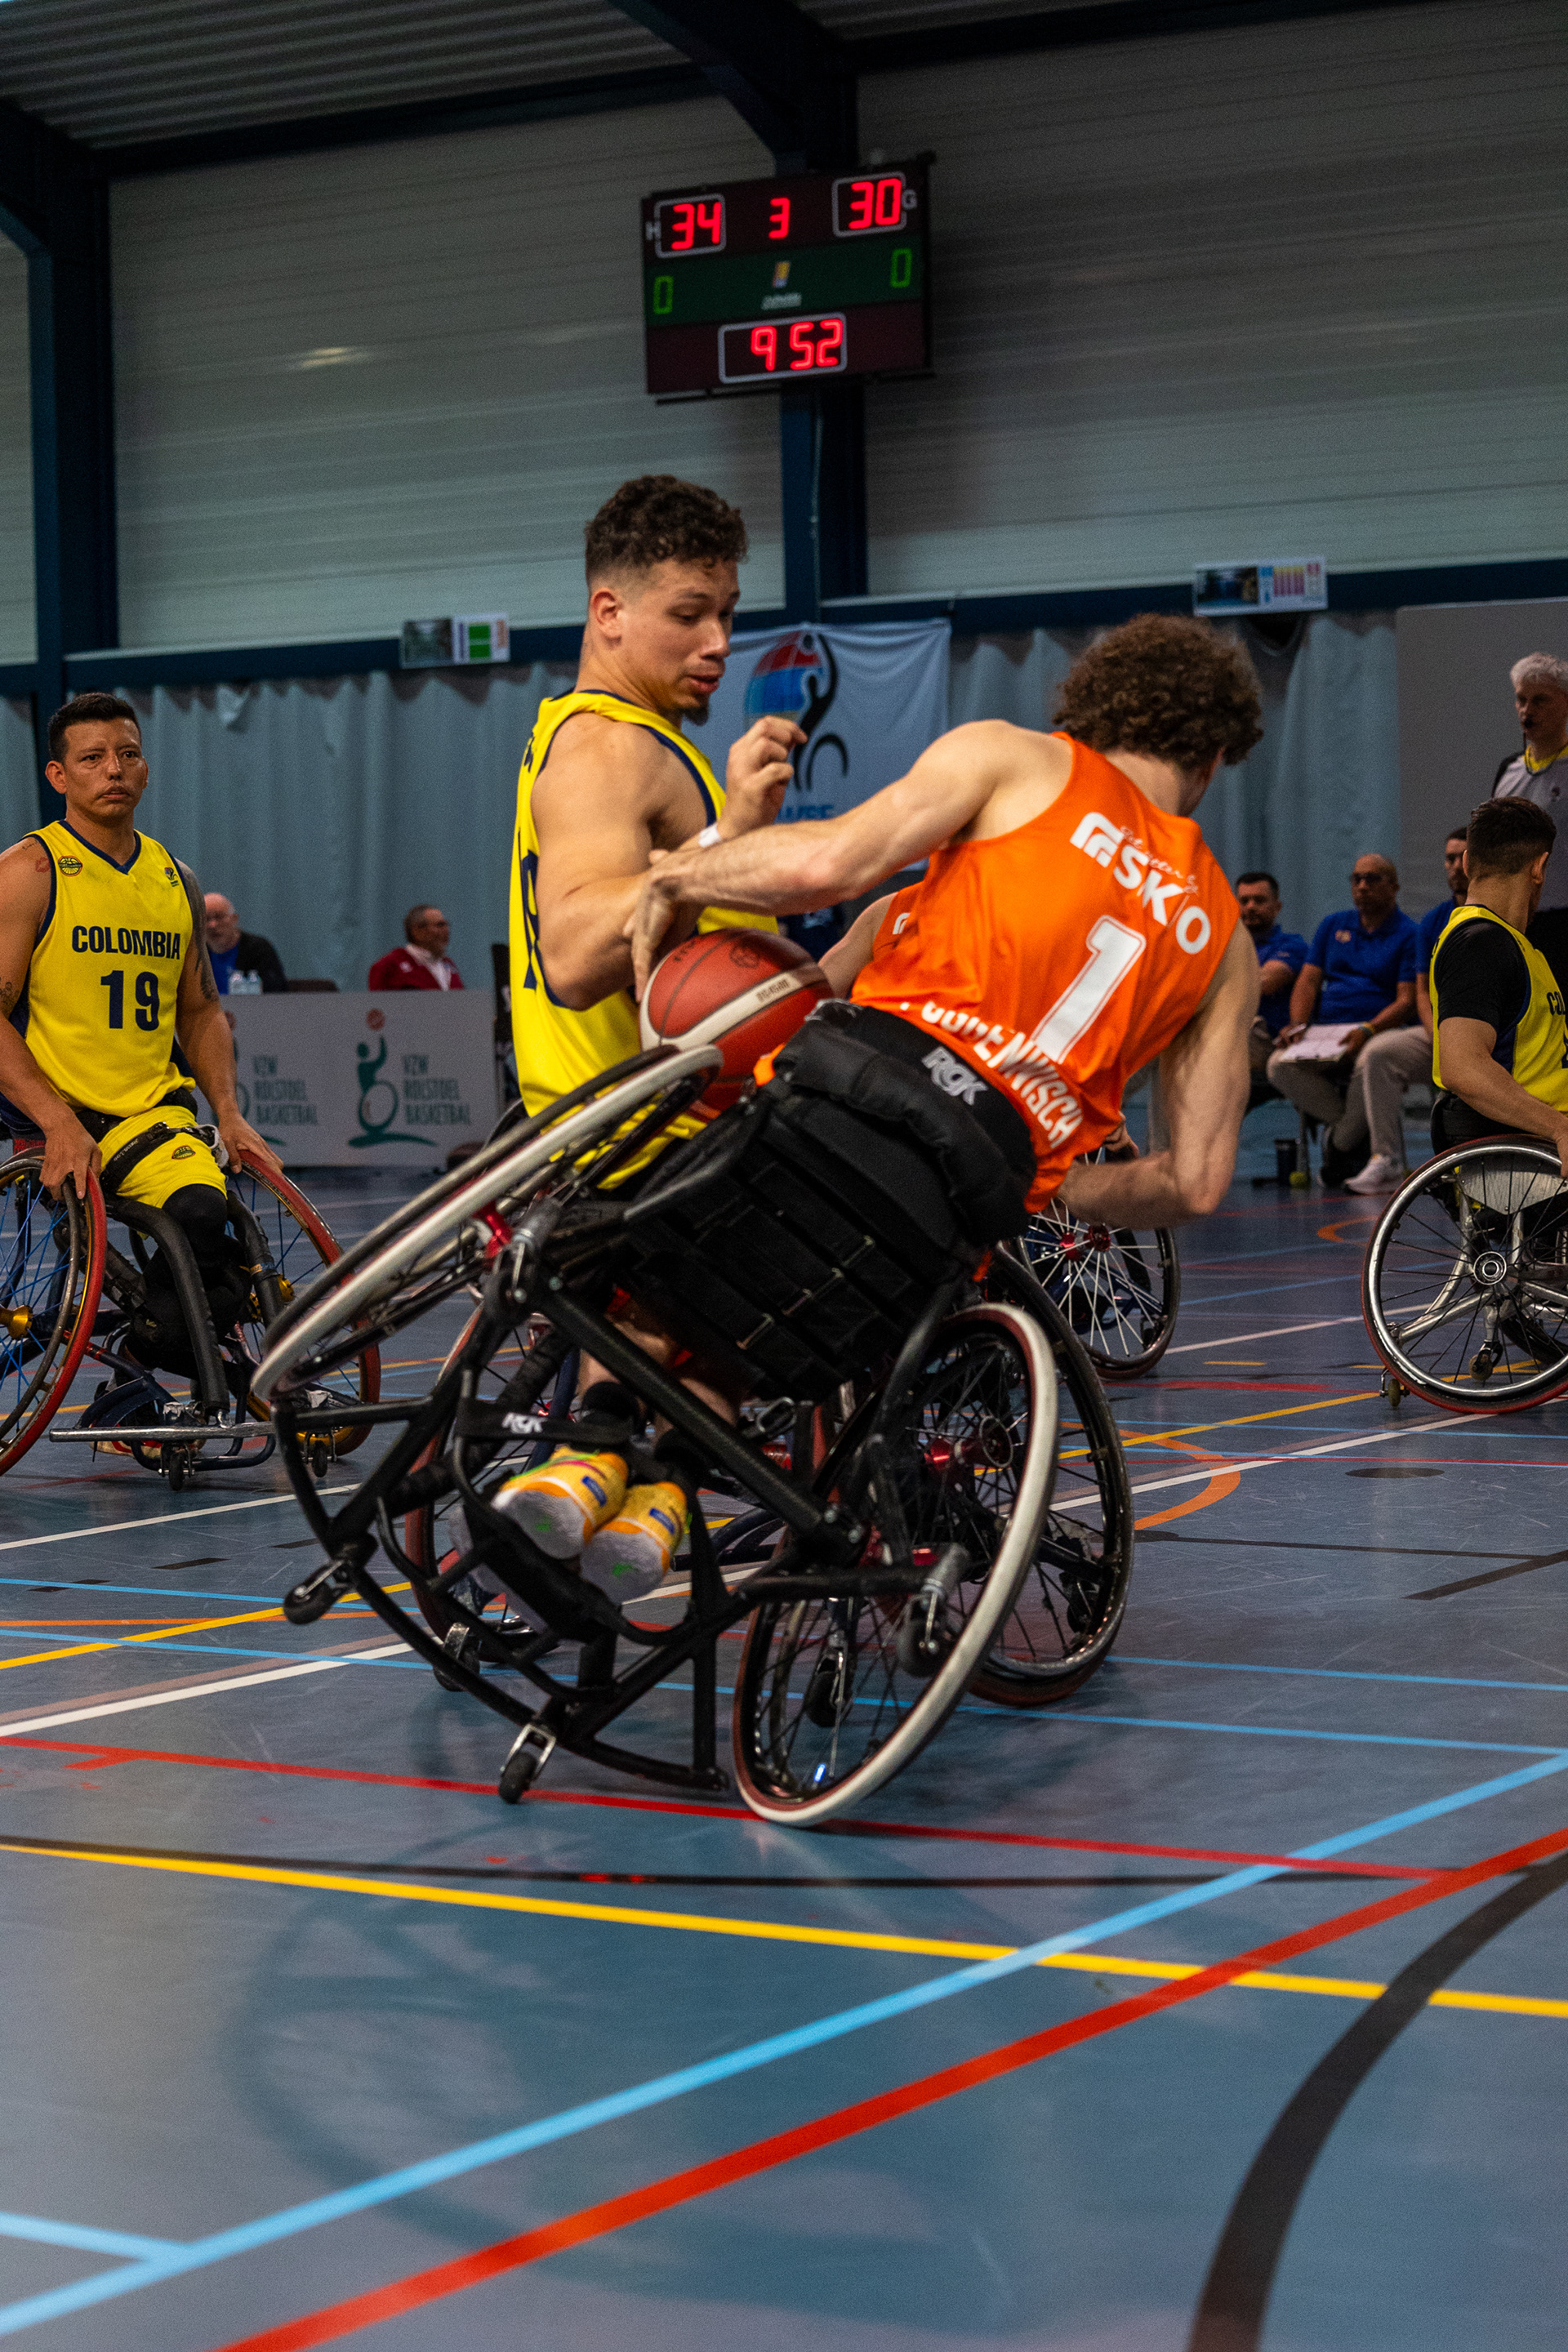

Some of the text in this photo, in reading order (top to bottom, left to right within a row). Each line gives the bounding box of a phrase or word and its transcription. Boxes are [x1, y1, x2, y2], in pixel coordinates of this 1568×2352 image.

[768, 198, 791, 239] 3
[848, 178, 902, 229] 30
[902, 189, 918, 209] G
[671, 203, 721, 251] 34
[889, 247, 912, 287] 0
[653, 275, 674, 314] 0
[1070, 812, 1211, 954] ASKO
[72, 925, 180, 960] COLOMBIA
[100, 969, 160, 1031] 19
[1031, 915, 1147, 1064] 1
[899, 1000, 1084, 1149] ENWISCH
[921, 1046, 988, 1106] RGK
[256, 1104, 319, 1125] BASKETBAL
[405, 1104, 471, 1125] BASKETBAL
